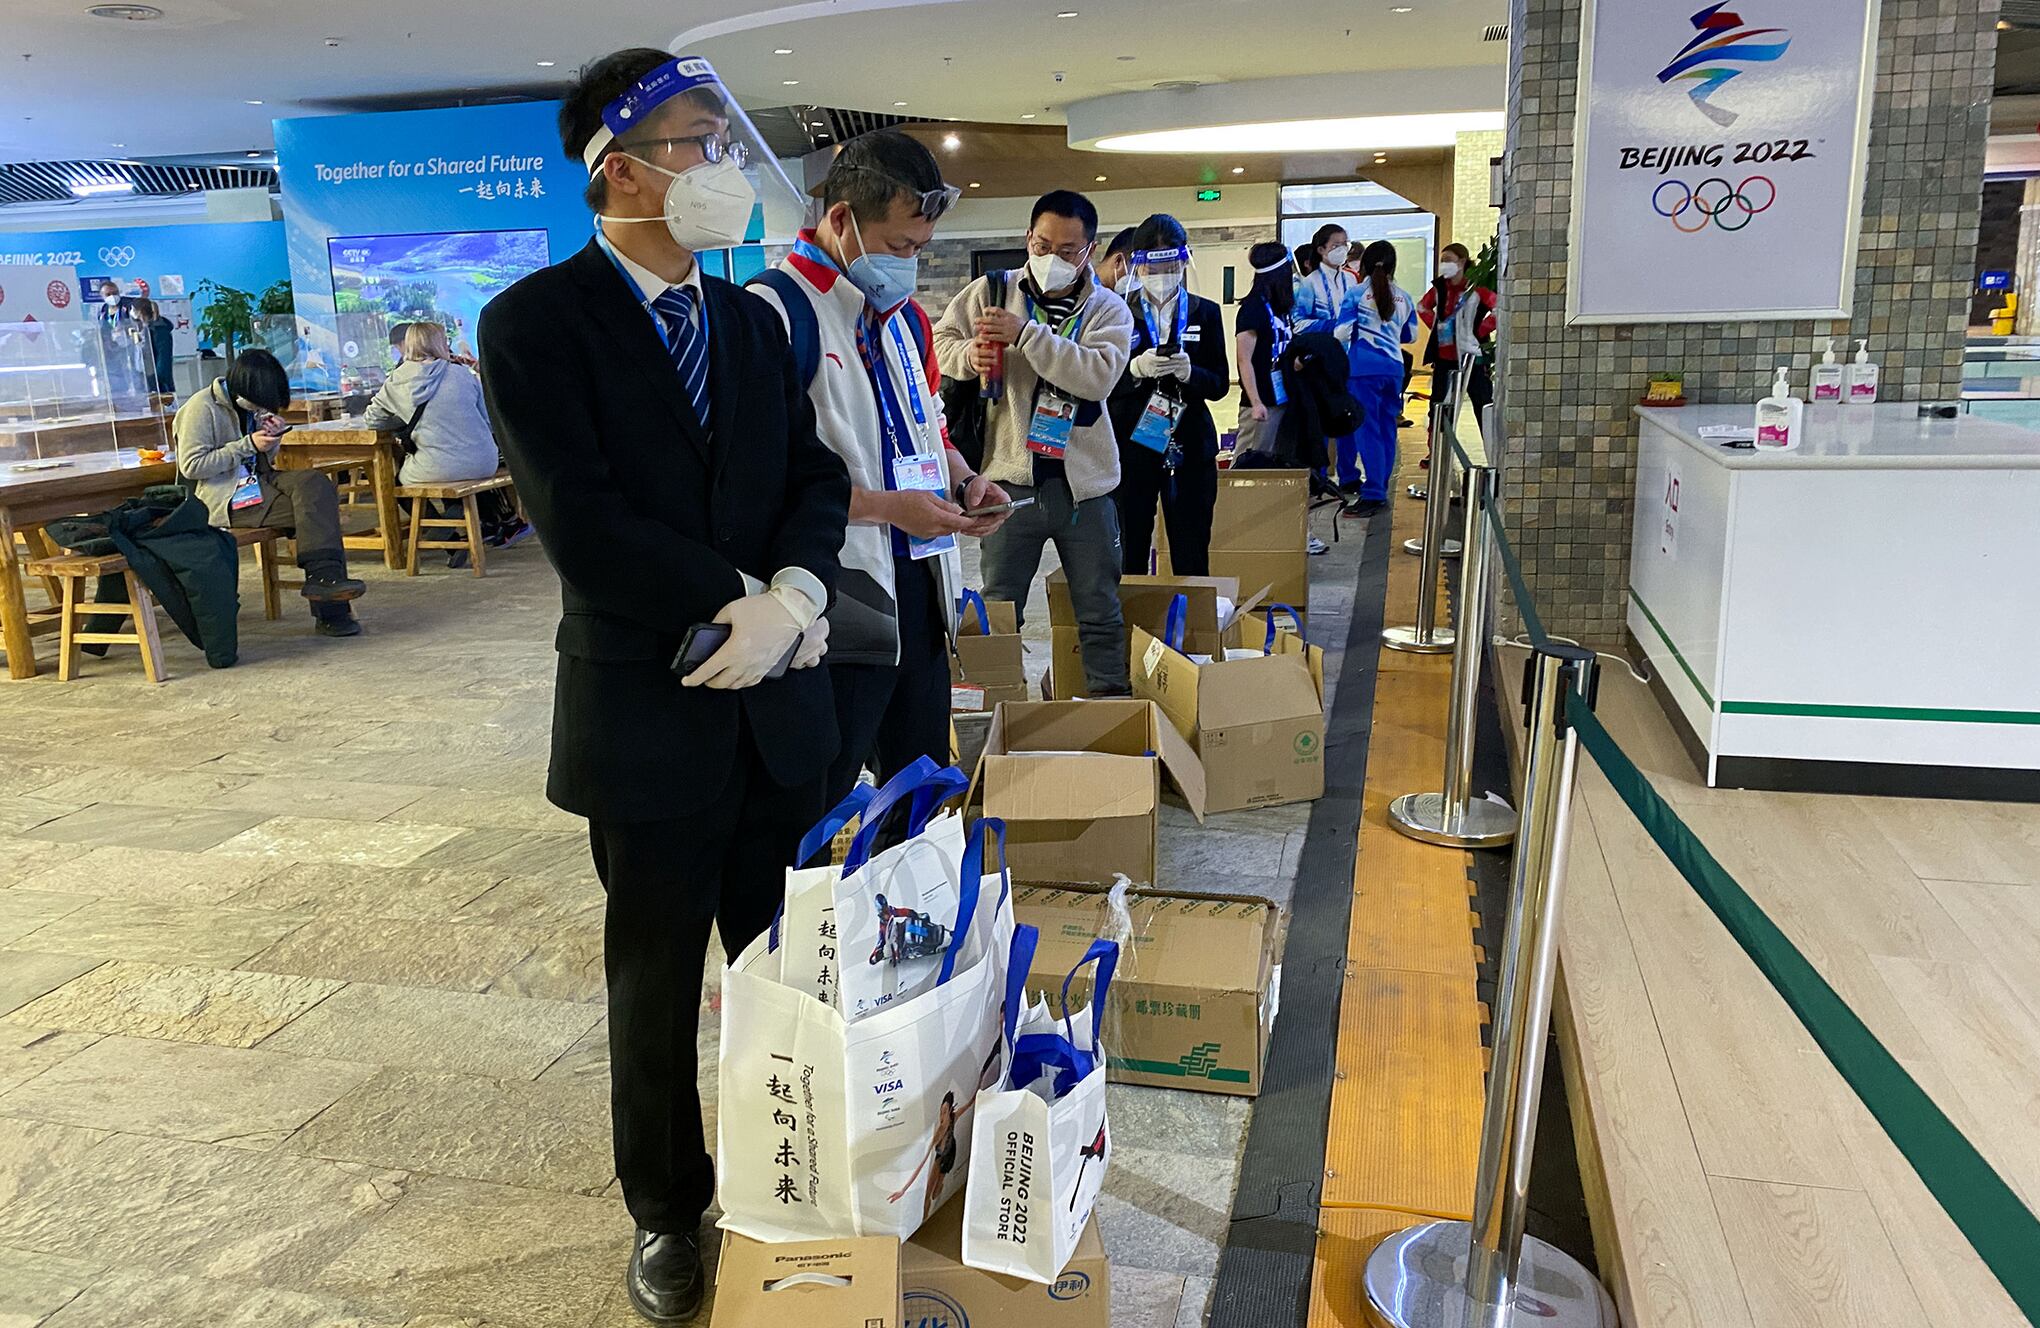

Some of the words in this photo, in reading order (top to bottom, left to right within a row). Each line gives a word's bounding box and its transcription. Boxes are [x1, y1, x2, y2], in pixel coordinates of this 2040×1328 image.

[314, 161, 384, 184] Together
[388, 159, 411, 177] for
[414, 162, 424, 176] a
[427, 155, 485, 175] Shared
[490, 155, 544, 173] Future
[1619, 144, 1725, 174] BEIJING
[1732, 139, 1816, 164] 2022
[458, 177, 546, 200] 一起向未来
[47, 251, 86, 266] 2022
[874, 993, 893, 1007] VISA
[800, 1063, 814, 1112] Together
[873, 1079, 903, 1095] VISA
[766, 1053, 802, 1204] 一起向未来
[806, 1111, 817, 1129] for
[807, 1128, 815, 1136] a
[807, 1135, 819, 1175] Shared
[1002, 1131, 1018, 1190] OFFICIAL
[1017, 1131, 1034, 1200] BEIJING
[809, 1174, 819, 1207] Future
[997, 1197, 1012, 1240] STORE
[1012, 1203, 1028, 1244] 2022
[774, 1251, 852, 1263] Panasonic
[1054, 1280, 1084, 1293] 伊利
